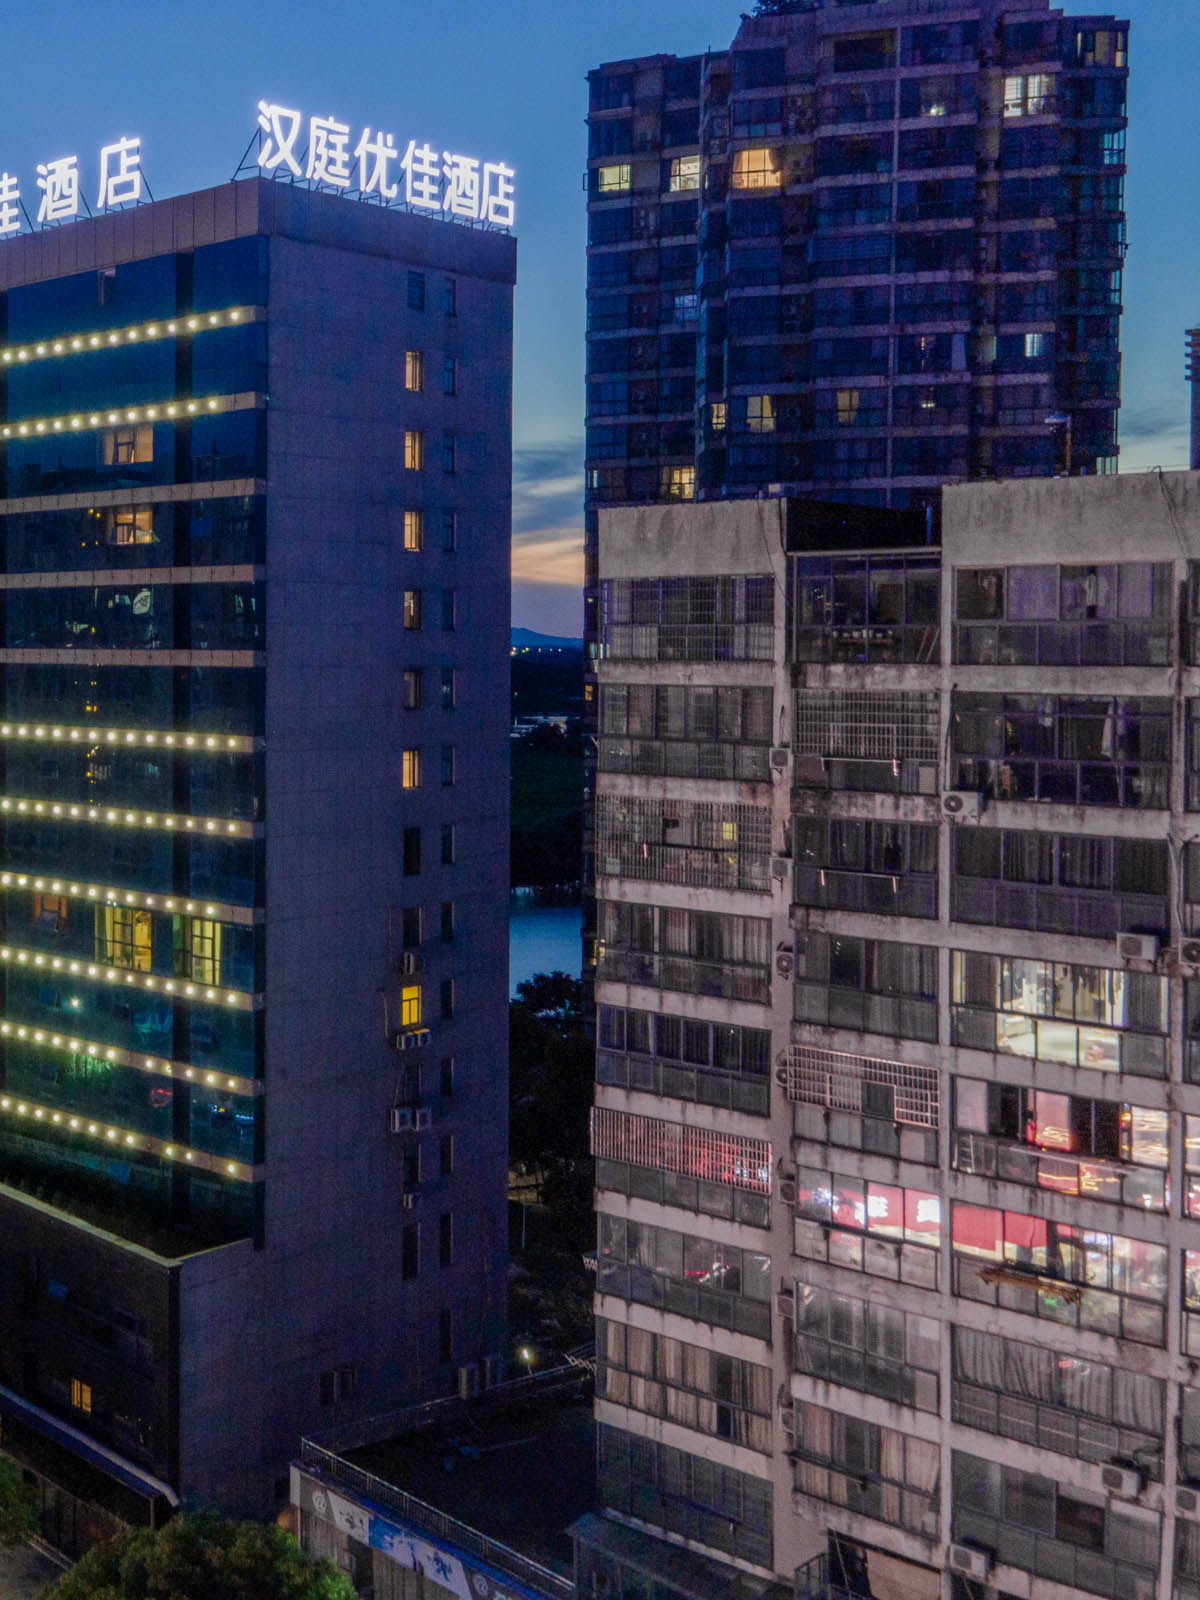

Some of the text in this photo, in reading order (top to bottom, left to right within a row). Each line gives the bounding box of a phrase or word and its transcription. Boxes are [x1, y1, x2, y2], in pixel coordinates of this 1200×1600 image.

[257, 100, 514, 226] 汉庭优佳酒店
